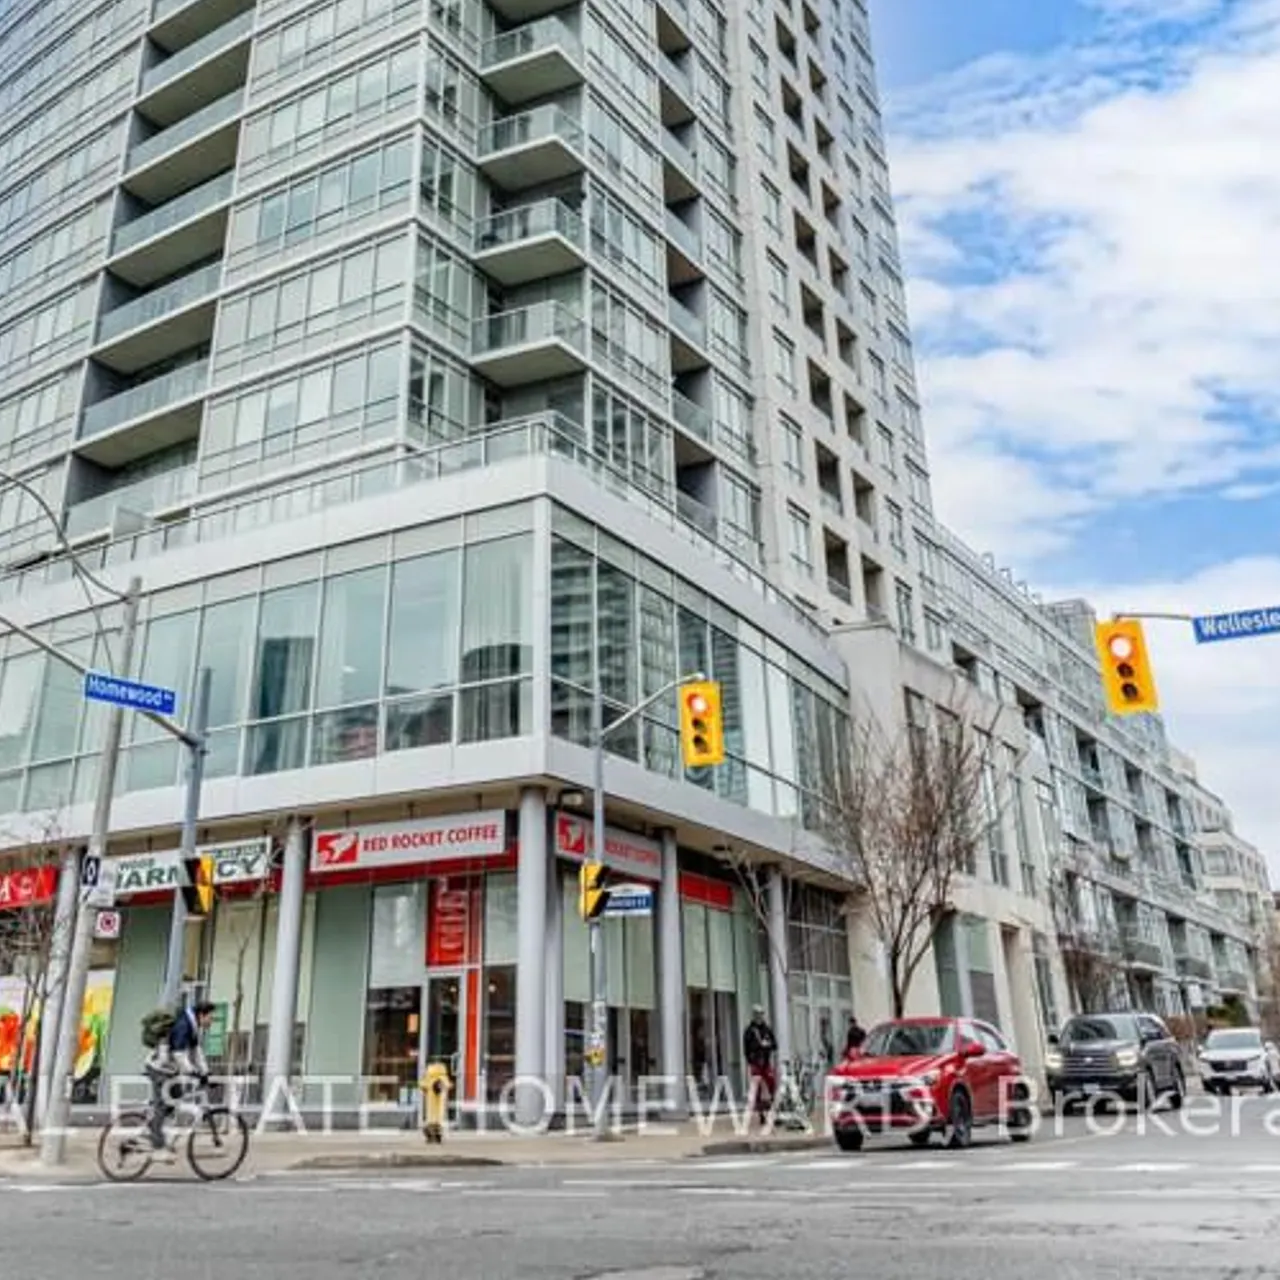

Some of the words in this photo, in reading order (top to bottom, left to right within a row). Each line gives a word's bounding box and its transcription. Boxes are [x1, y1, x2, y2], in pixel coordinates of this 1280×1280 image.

[89, 675, 162, 707] Homewood
[363, 839, 389, 852] RED
[391, 830, 446, 851] ROCKET
[447, 823, 498, 845] COFFEE
